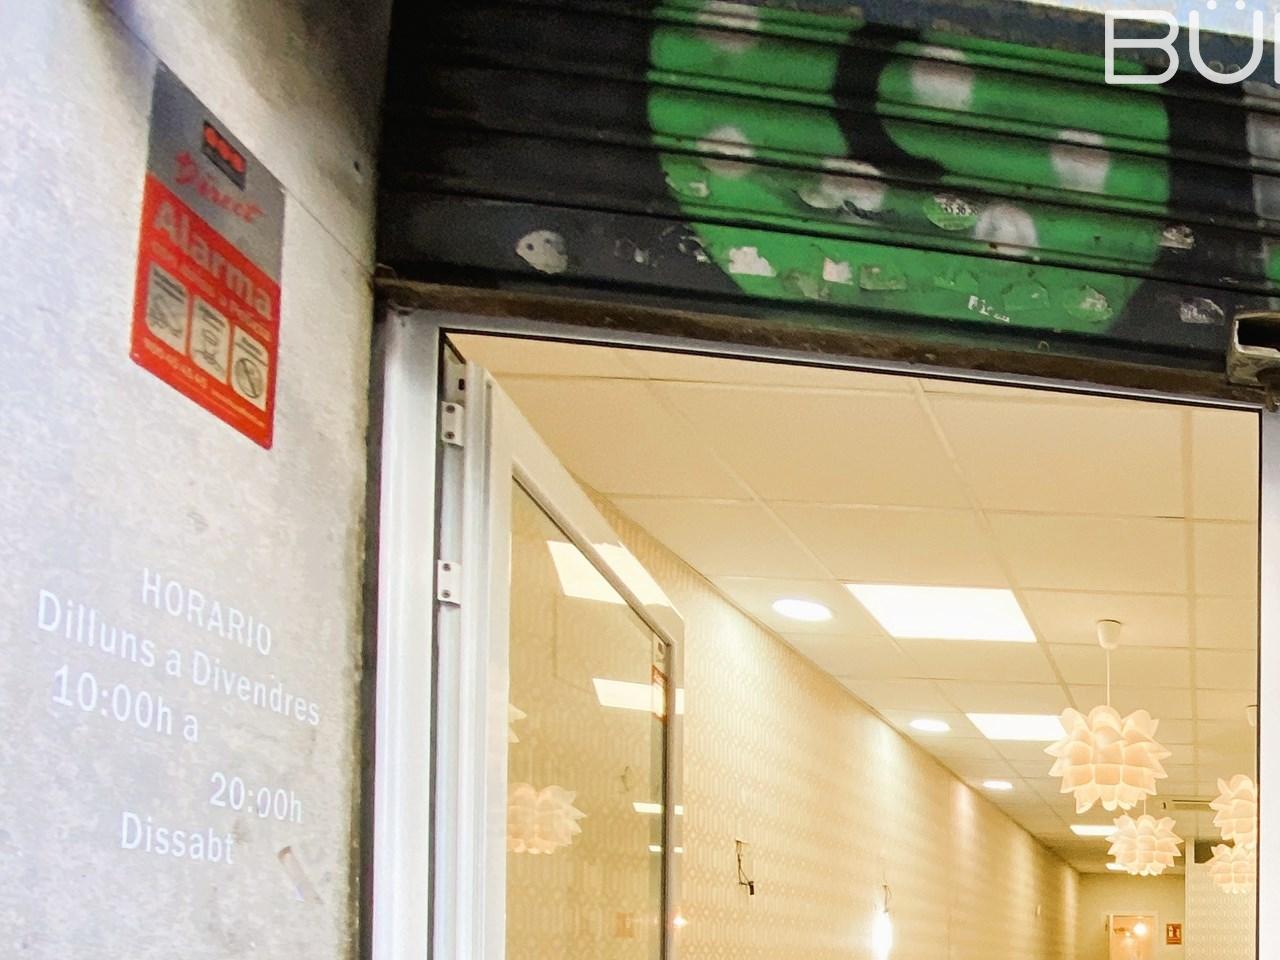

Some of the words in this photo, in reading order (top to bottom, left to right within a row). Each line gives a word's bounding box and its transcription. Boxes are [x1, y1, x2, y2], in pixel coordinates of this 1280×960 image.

[153, 202, 272, 320] Alarma
[142, 567, 273, 656] HORARIO
[37, 588, 157, 668] Dilluns
[165, 648, 183, 678] a
[192, 650, 321, 726] Divendres
[51, 664, 173, 736] 10:00h
[183, 714, 199, 742] a
[121, 811, 234, 865] Dissabt
[209, 772, 303, 824] 20:00h
